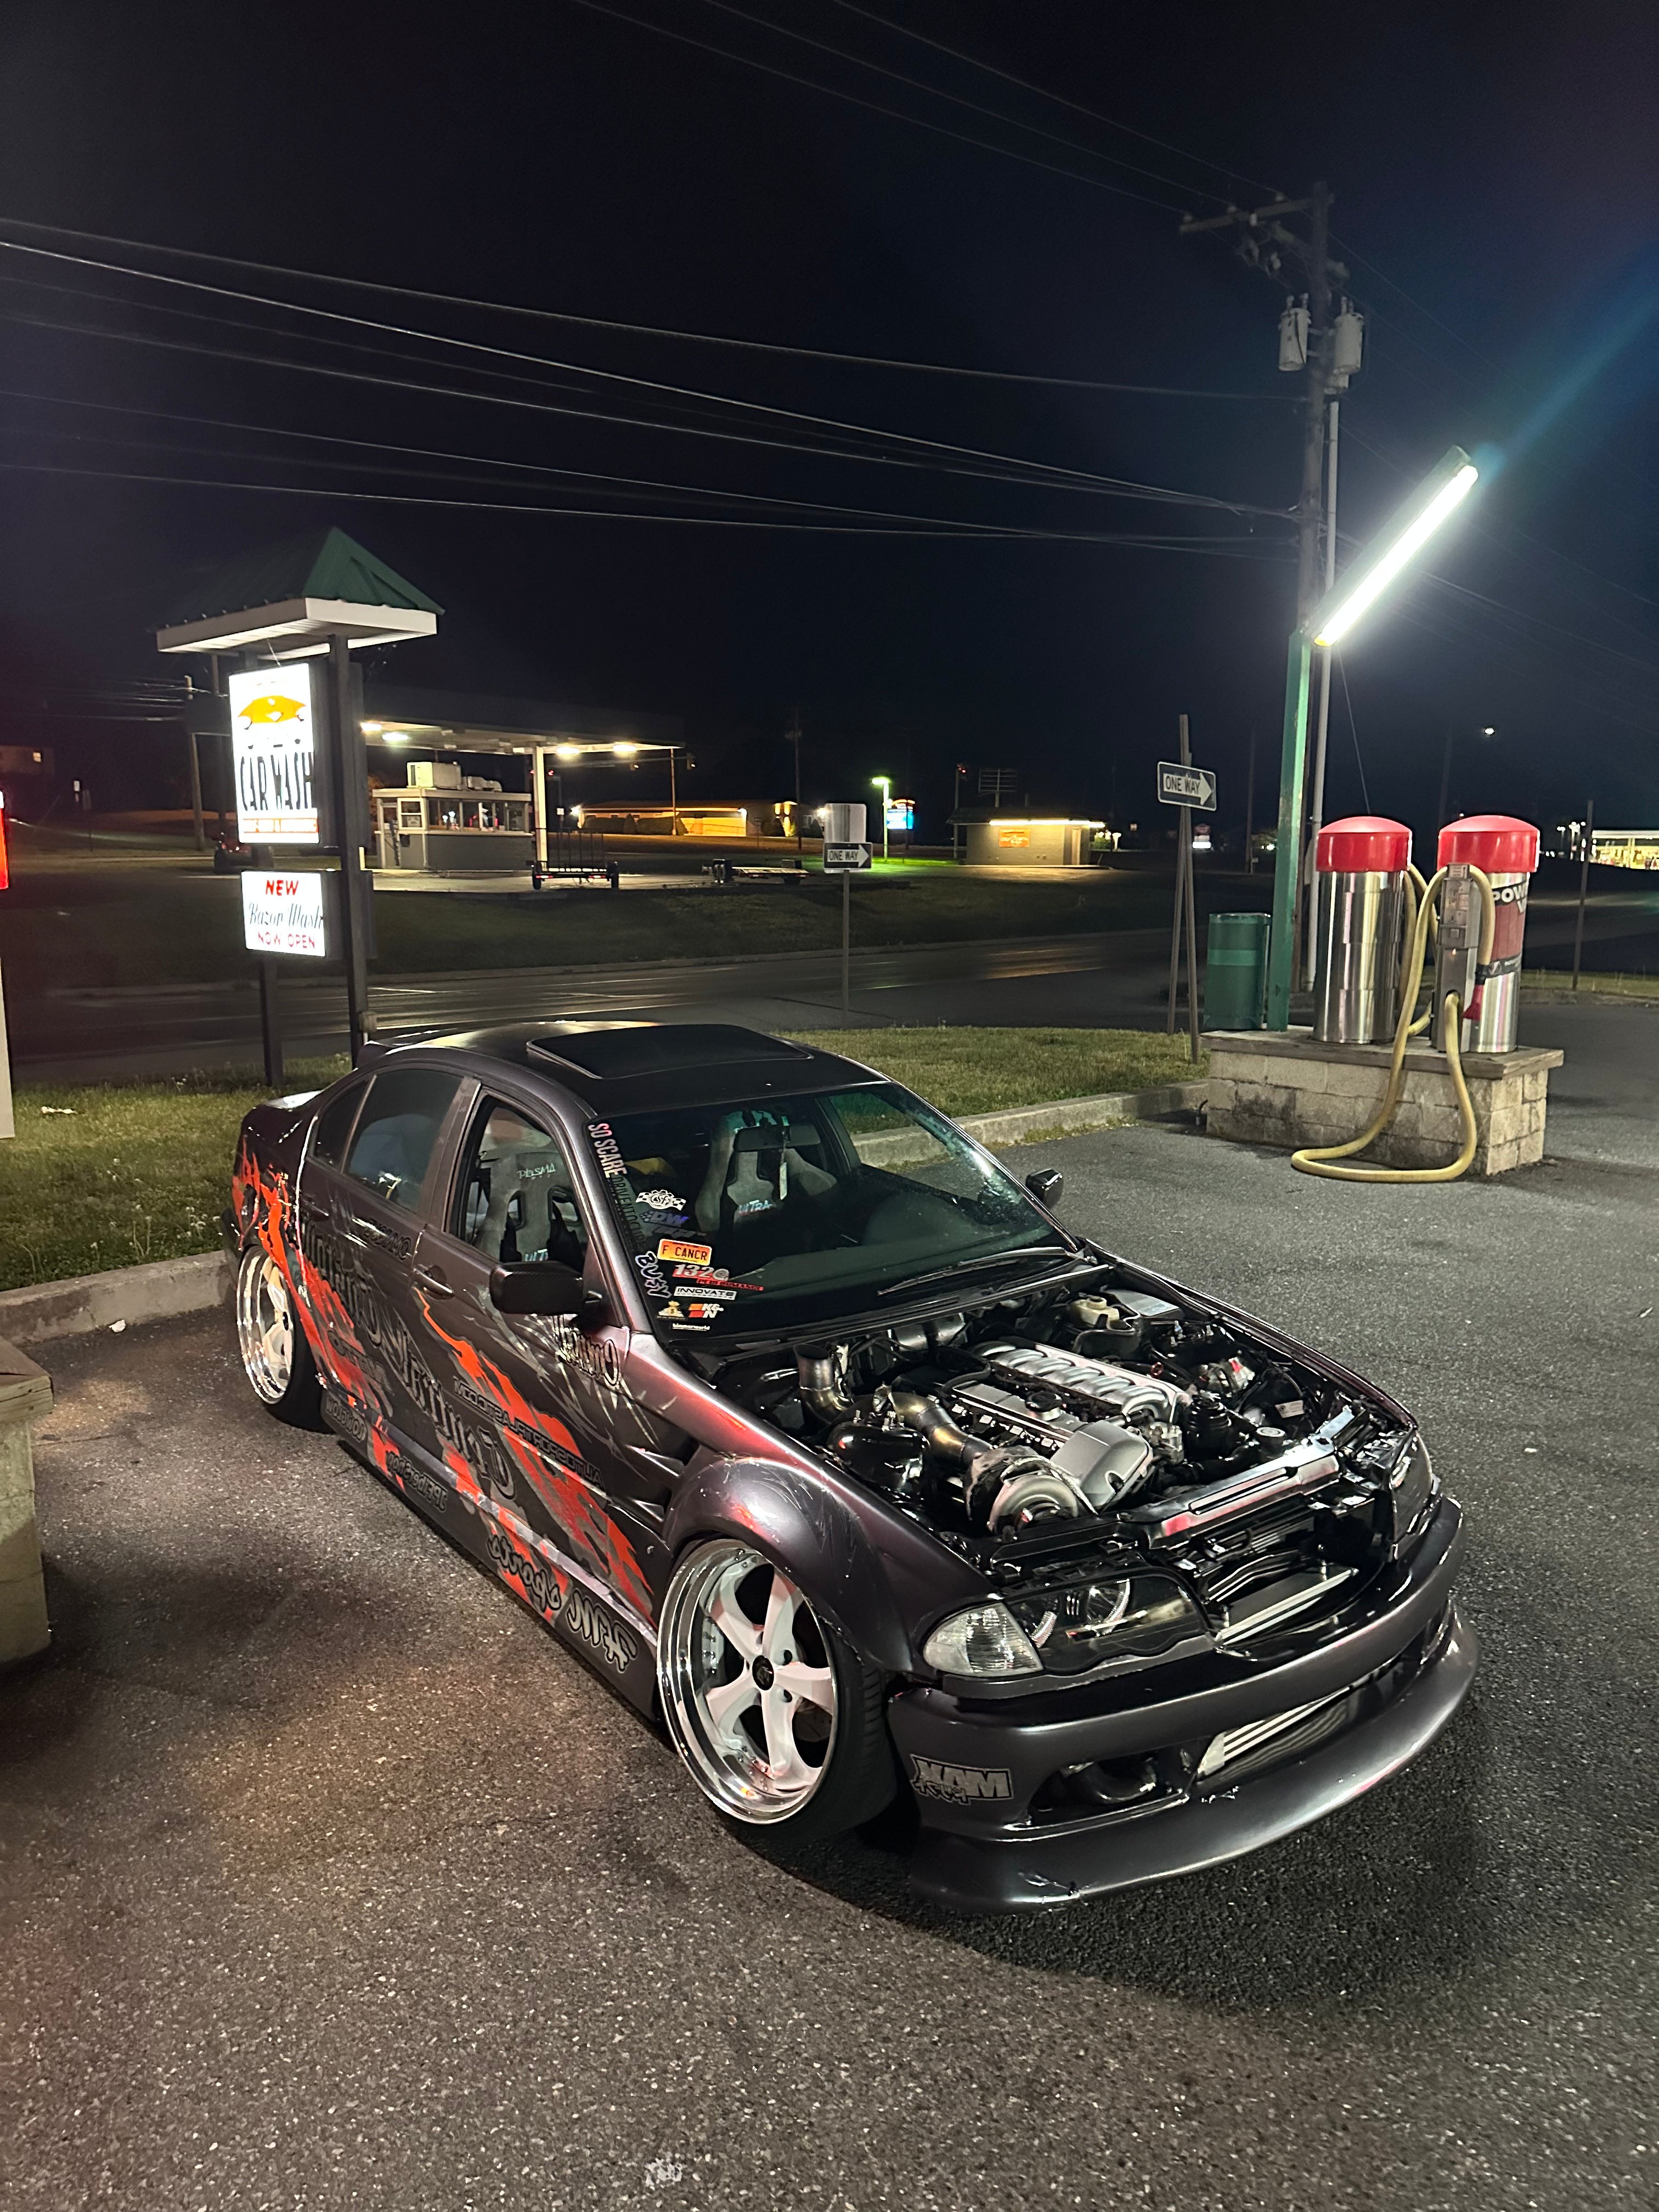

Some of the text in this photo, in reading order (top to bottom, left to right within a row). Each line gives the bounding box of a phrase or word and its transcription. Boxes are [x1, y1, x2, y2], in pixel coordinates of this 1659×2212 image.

[240, 752, 314, 811] CAR WASH
[1166, 776, 1200, 795] ONE WAY
[828, 850, 859, 861] ONE WAY
[266, 879, 299, 896] NEW
[249, 902, 324, 929] Razor Wash
[258, 932, 315, 949] NOW OPEN
[588, 1123, 613, 1138] SO
[594, 1138, 628, 1178] SCARE
[662, 1245, 669, 1255] F
[675, 1246, 708, 1261] CANCR
[677, 1288, 735, 1296] INNOVATE
